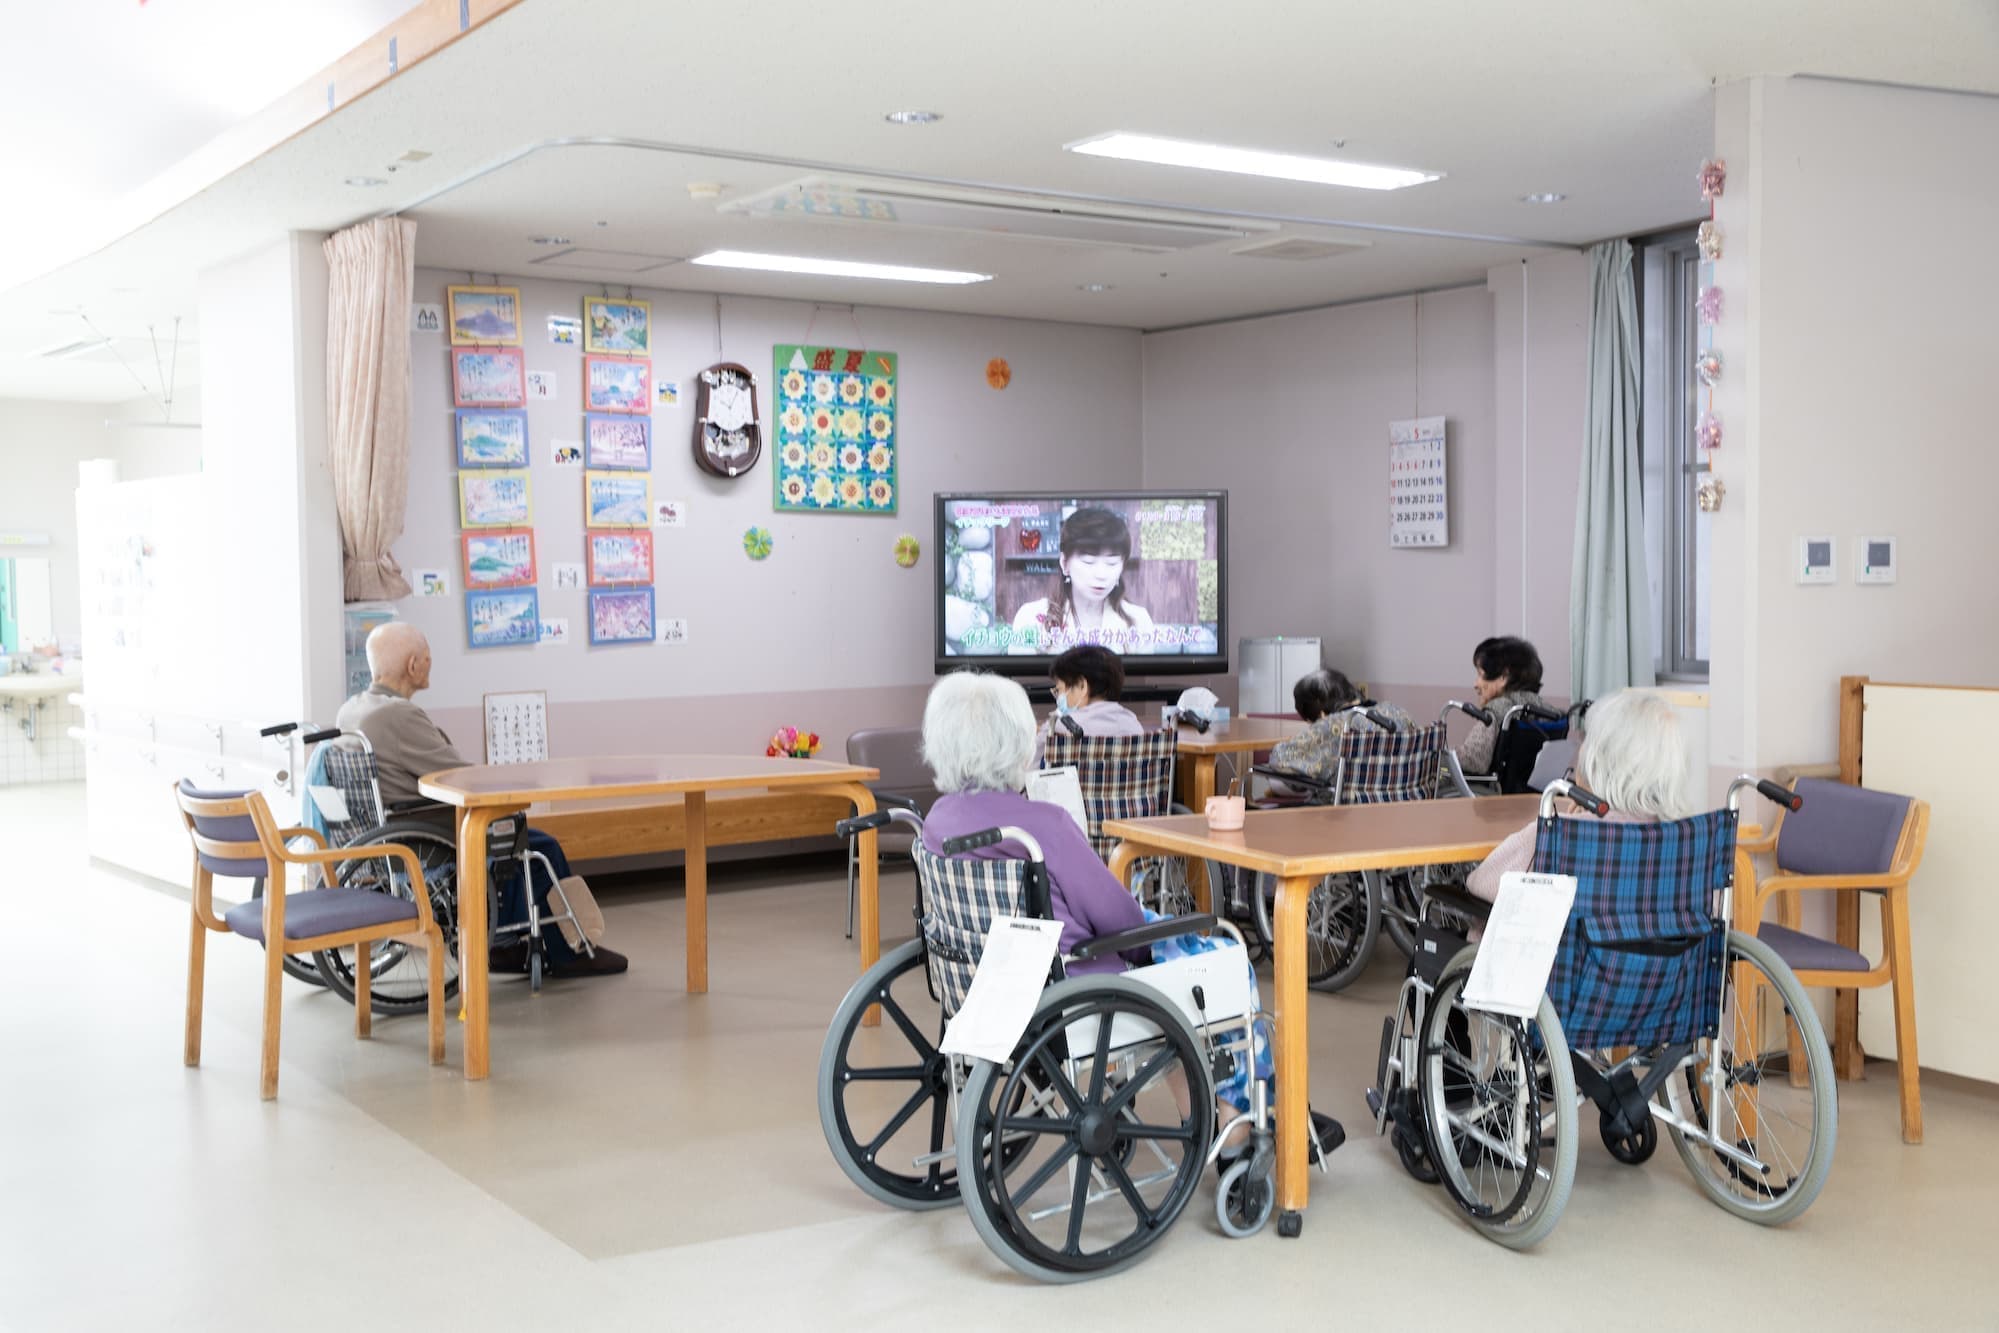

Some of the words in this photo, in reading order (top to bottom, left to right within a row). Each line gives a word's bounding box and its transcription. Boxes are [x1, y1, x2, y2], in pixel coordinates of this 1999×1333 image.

[1397, 479, 1403, 488] 11
[1405, 478, 1411, 488] 12
[1412, 478, 1418, 488] 13
[1420, 477, 1426, 487] 14
[1428, 476, 1434, 486] 15
[1436, 476, 1443, 486] 16
[1397, 496, 1403, 505] 18
[1405, 496, 1411, 505] 19
[1412, 495, 1418, 504] 20
[1420, 495, 1426, 504] 21
[1428, 494, 1434, 503] 22
[1436, 494, 1443, 503] 23
[1397, 512, 1403, 522] 25
[1404, 512, 1411, 521] 26
[1412, 512, 1418, 521] 27
[1420, 512, 1426, 521] 28
[1427, 511, 1435, 520] 29
[1436, 511, 1443, 520] 30
